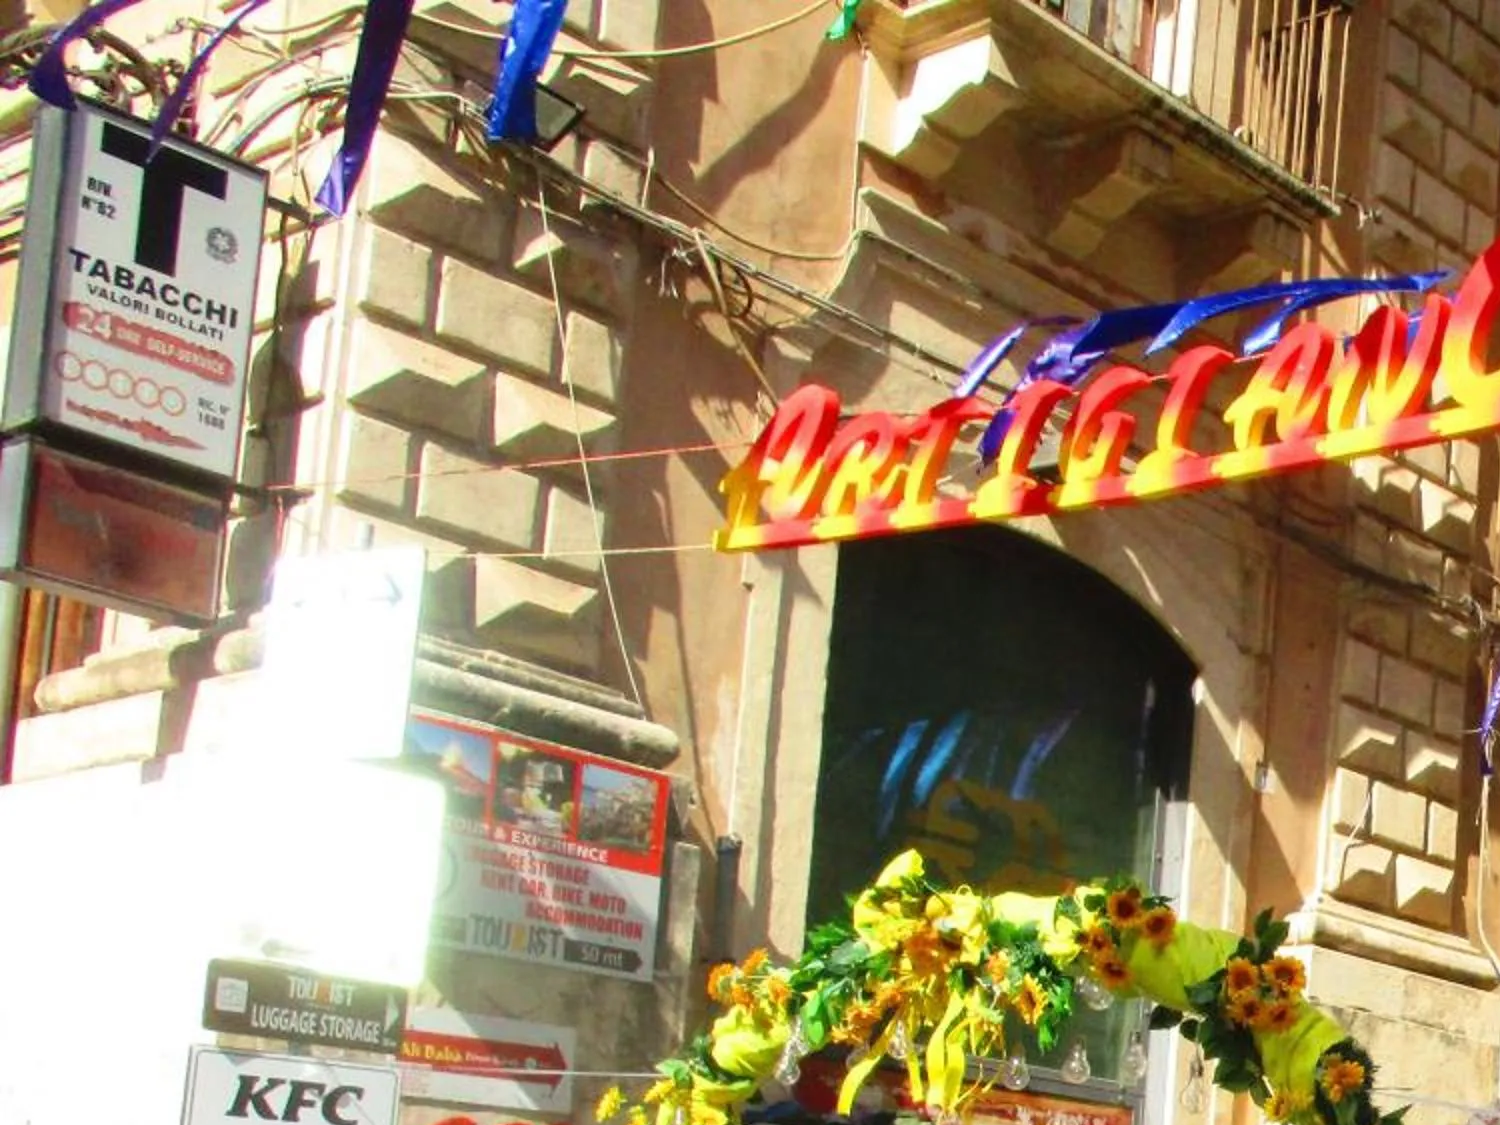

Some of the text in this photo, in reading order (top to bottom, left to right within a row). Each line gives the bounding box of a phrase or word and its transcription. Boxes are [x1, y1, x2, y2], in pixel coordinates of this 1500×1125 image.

[69, 247, 239, 329] TABACCHI
[76, 303, 113, 341] 24
[86, 283, 224, 342] VALORI BOLLATI
[468, 912, 564, 960] TOUIST
[287, 974, 357, 1007] TOUIST
[251, 1003, 381, 1043] LUGGAGE STORAGE
